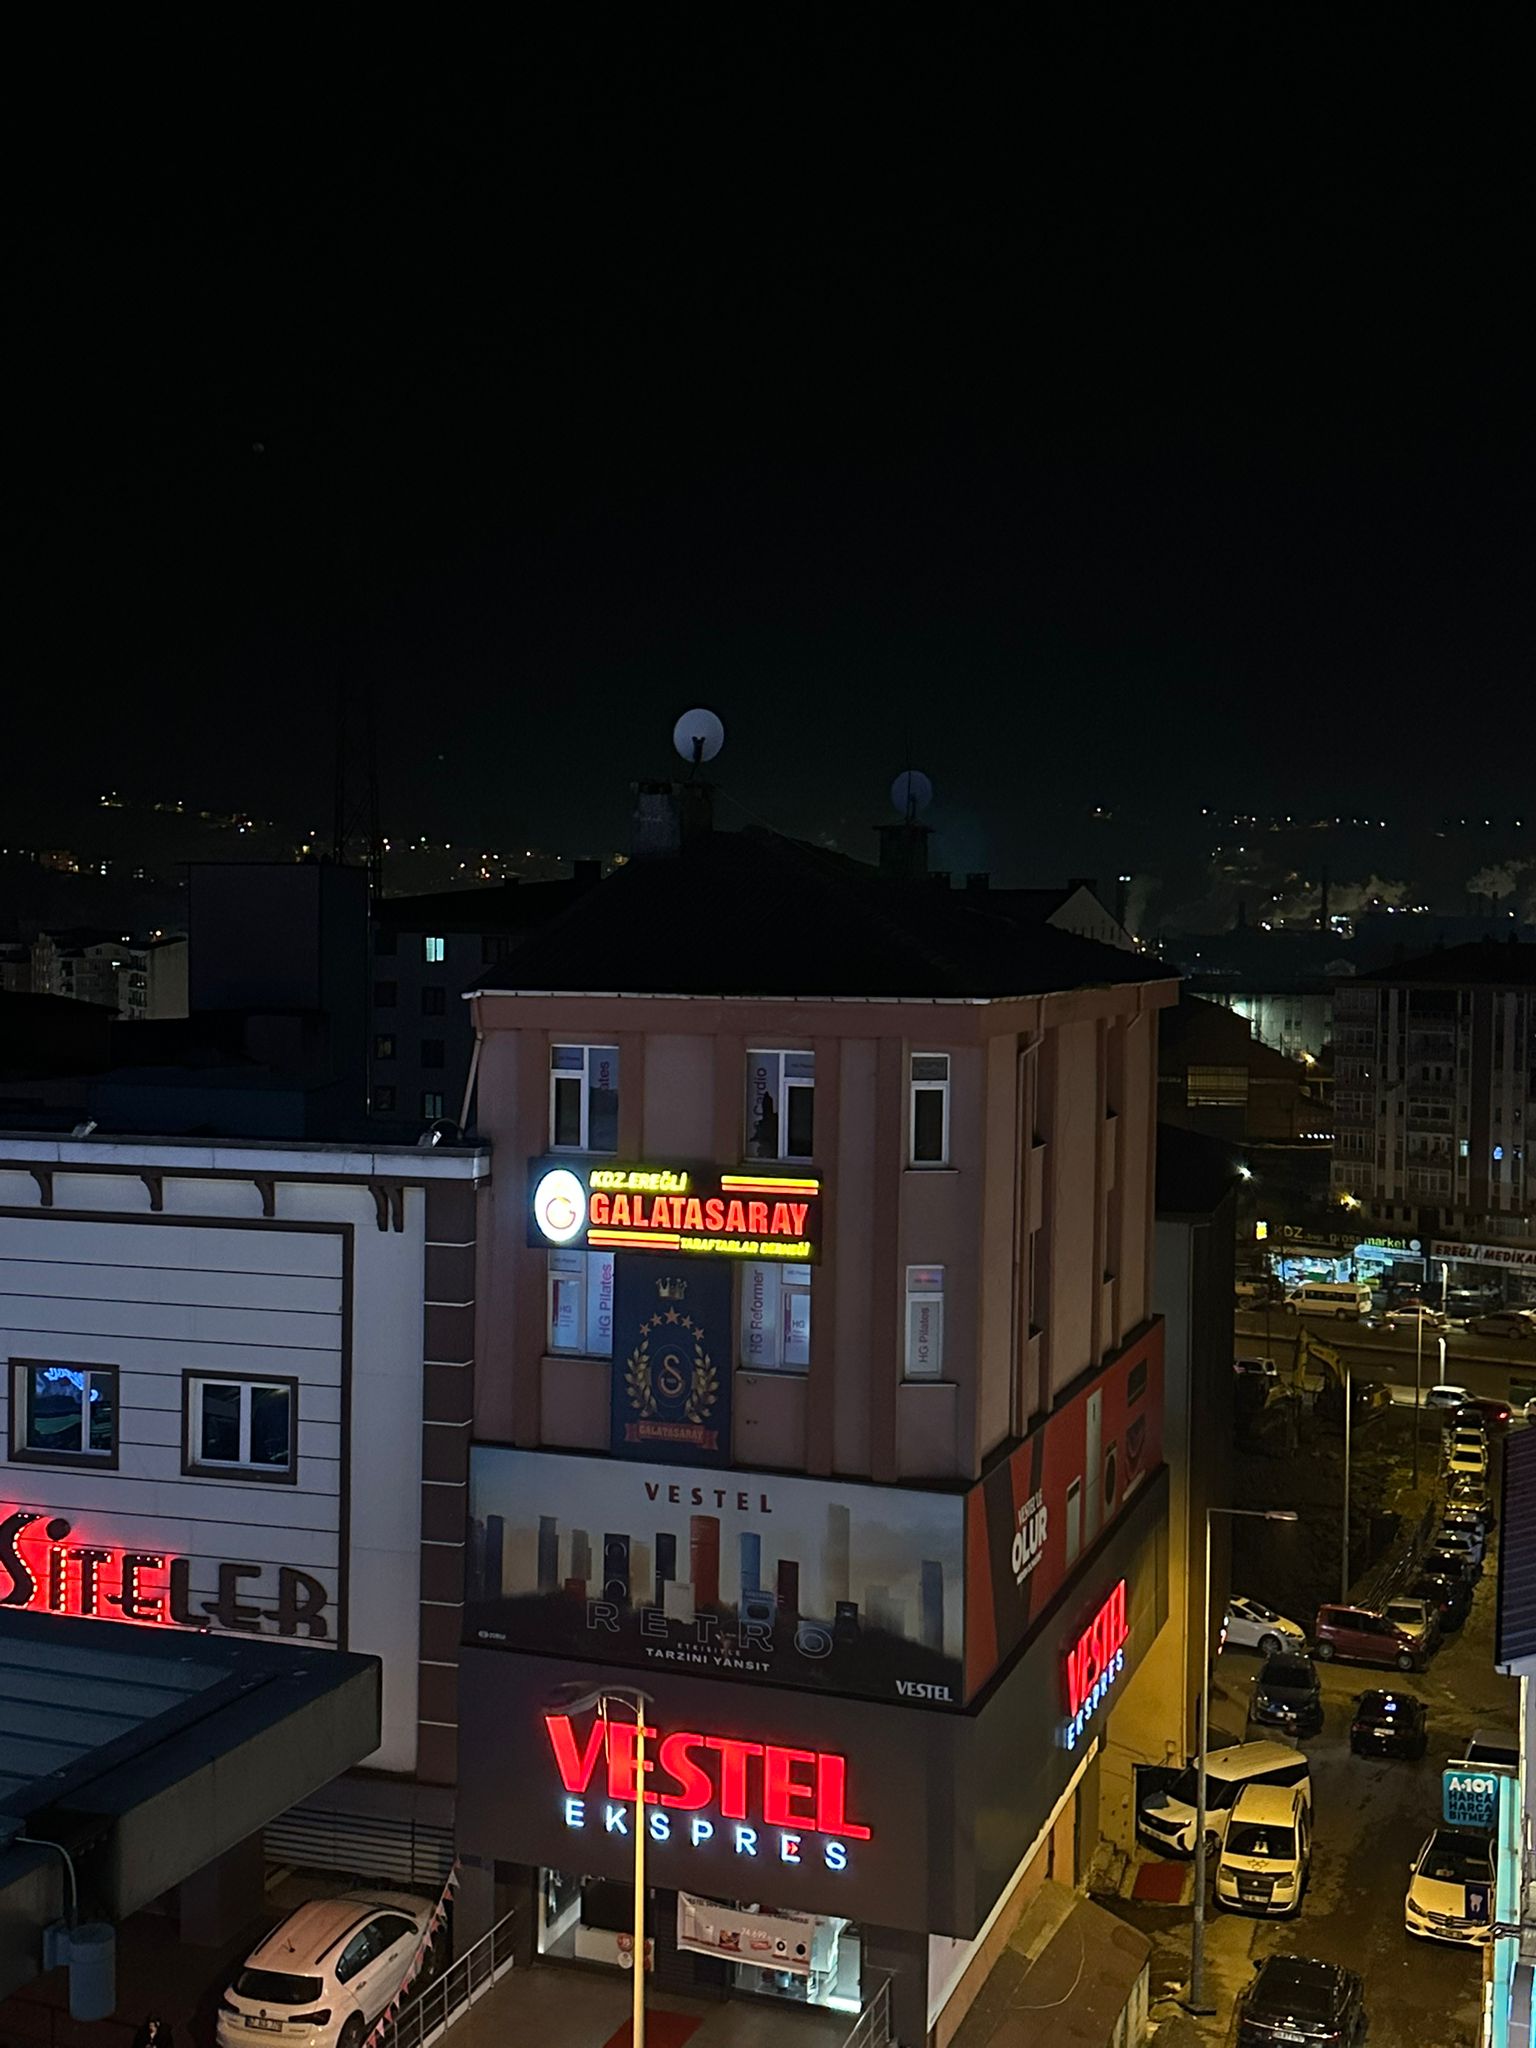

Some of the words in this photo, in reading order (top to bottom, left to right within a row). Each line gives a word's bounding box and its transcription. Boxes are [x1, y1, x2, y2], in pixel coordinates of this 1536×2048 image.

[590, 1193, 809, 1236] GALATASARAY
[1363, 1236, 1407, 1249] market
[599, 1263, 613, 1311] Pilates
[750, 1270, 765, 1330] Reformer
[598, 1315, 611, 1338] HG
[918, 1307, 930, 1343] Pilates
[749, 1334, 763, 1354] HG
[918, 1345, 929, 1363] HG
[638, 1424, 704, 1441] GALATASARAY
[644, 1482, 773, 1514] VESTEL
[1011, 1504, 1048, 1574] OLUR
[586, 1600, 834, 1659] RETRO
[1067, 1578, 1129, 1718] VESTEL
[712, 1656, 771, 1673] YANSIT
[895, 1679, 954, 1702] VESTEL
[545, 1715, 872, 1840] VESTEL
[1449, 1790, 1493, 1804] HARCA
[1449, 1800, 1493, 1813] HARCA
[565, 1799, 848, 1871] EKSPRES
